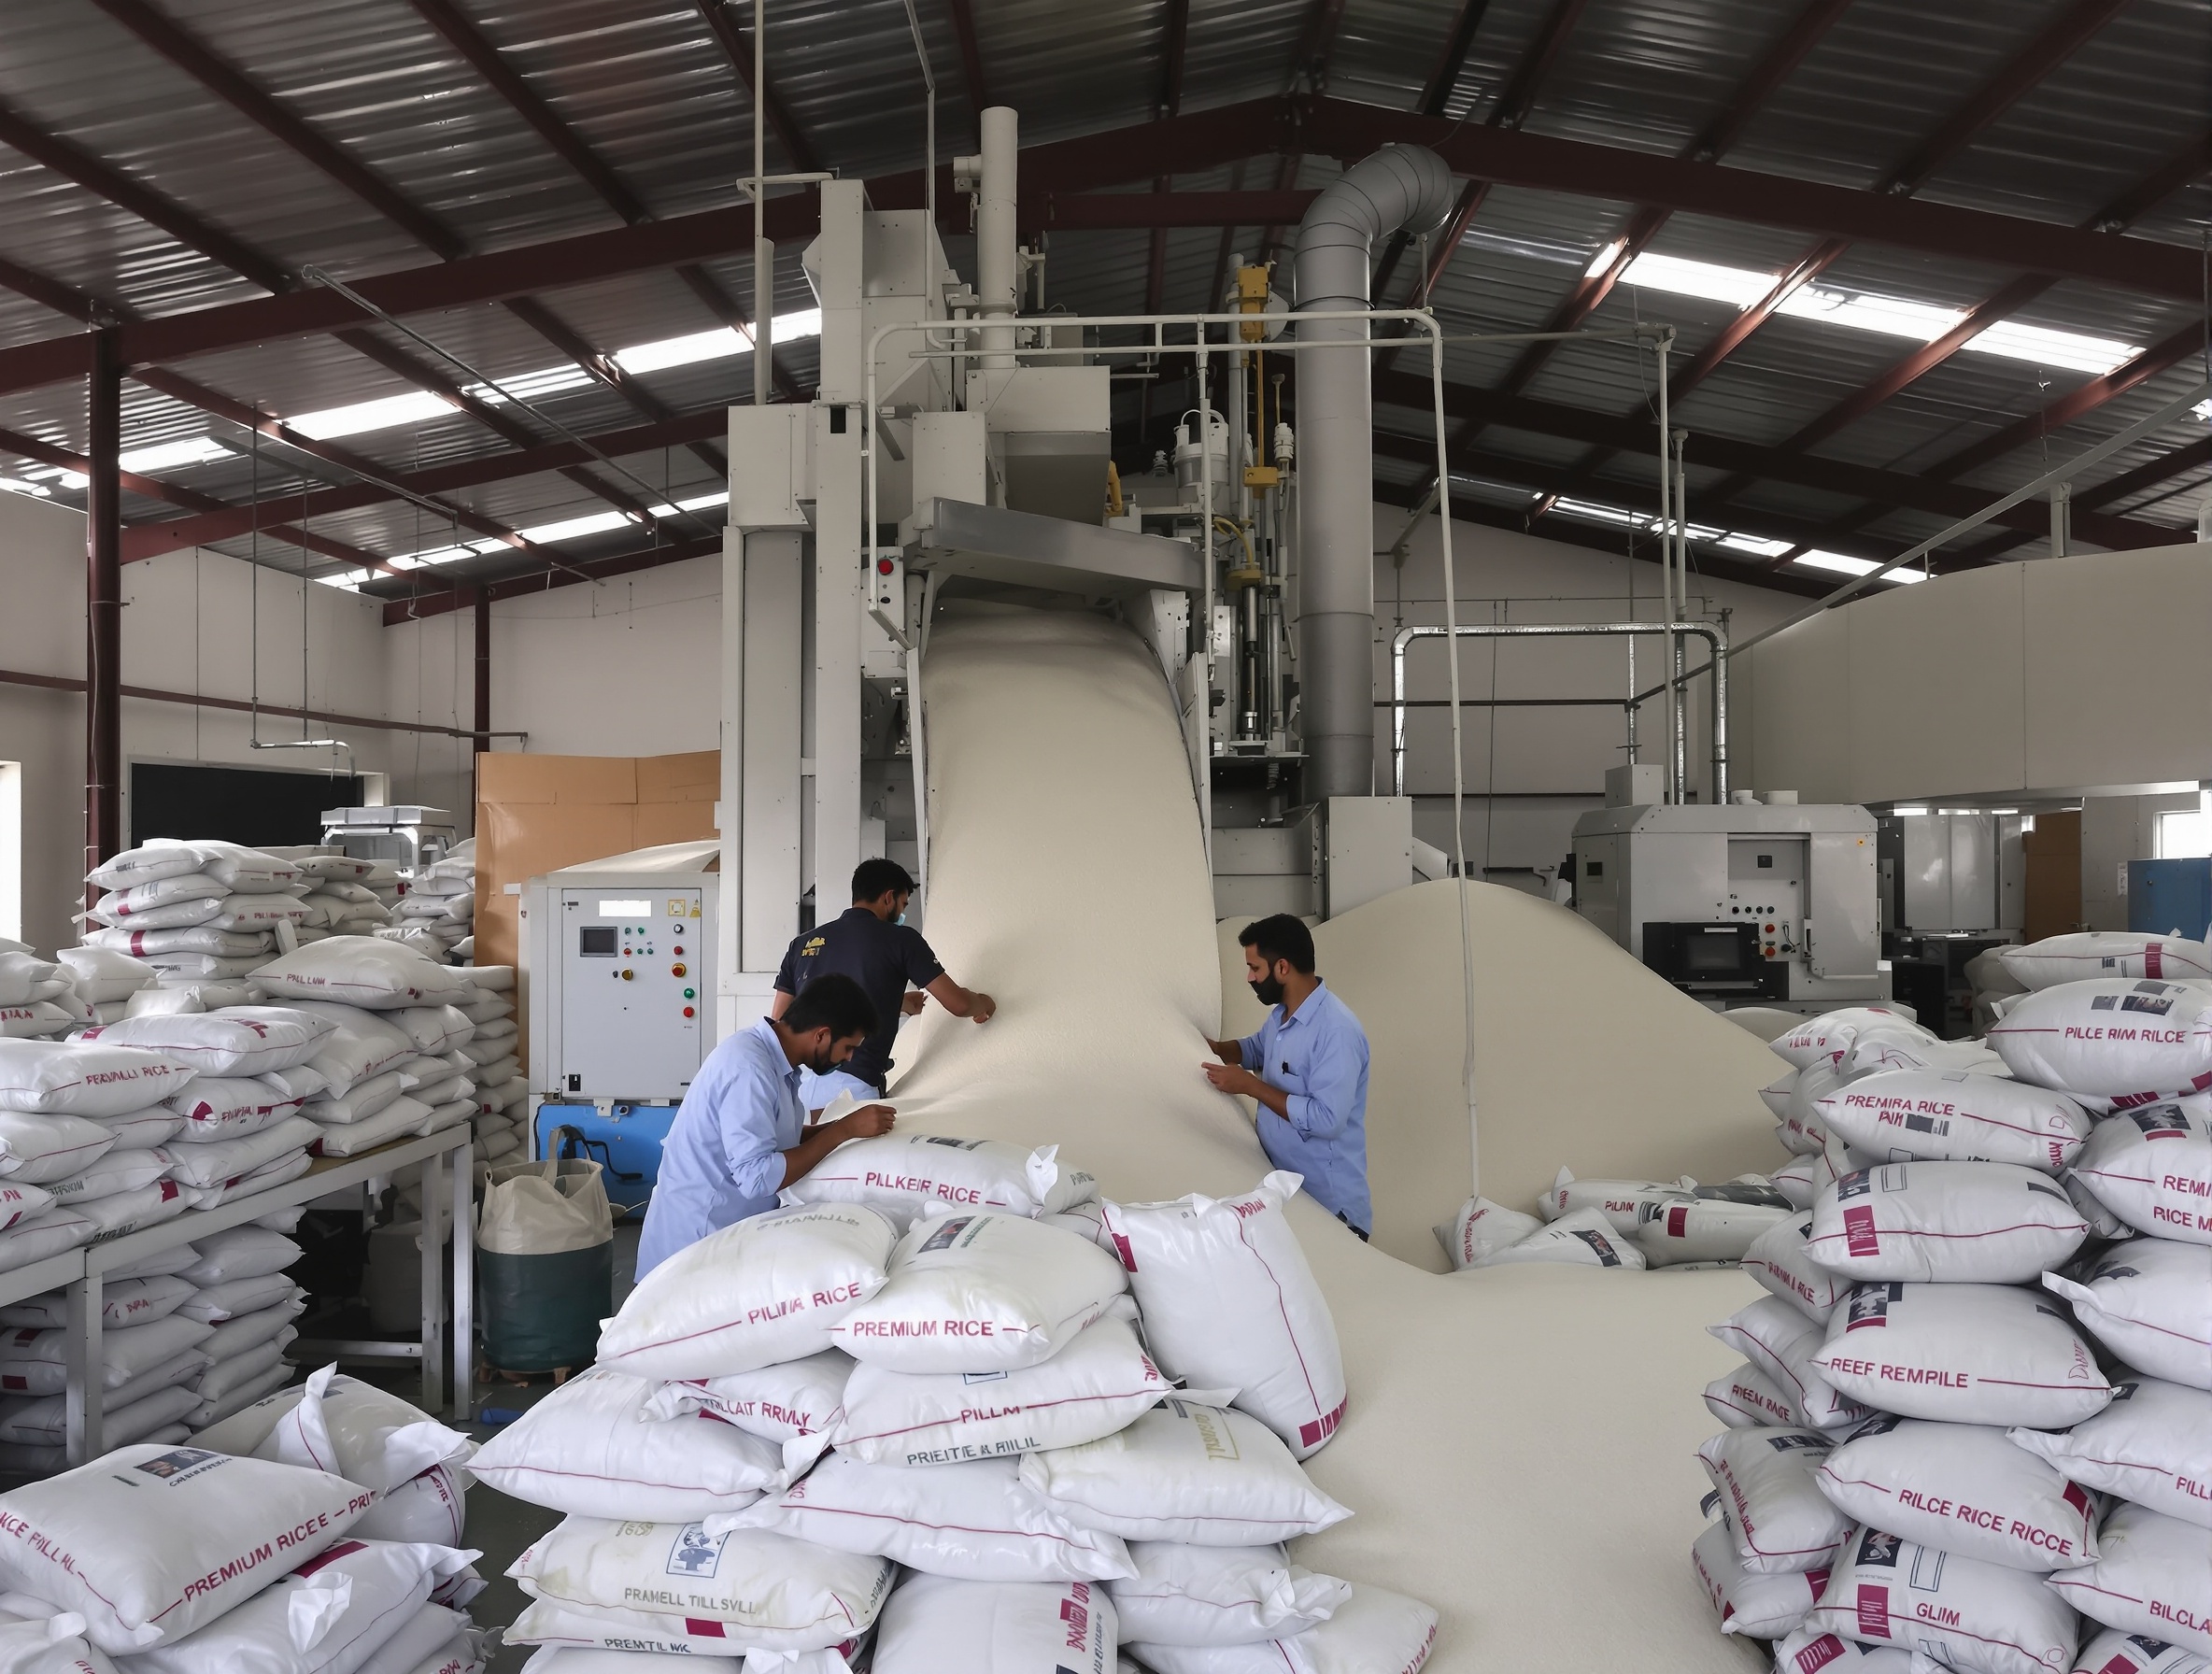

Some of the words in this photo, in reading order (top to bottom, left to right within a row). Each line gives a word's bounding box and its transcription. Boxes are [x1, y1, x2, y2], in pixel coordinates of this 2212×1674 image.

[1917, 1100, 1956, 1116] RICE
[937, 1184, 982, 1205] RICE
[2153, 1205, 2192, 1228] RICE
[812, 1282, 862, 1308] RICE
[853, 1320, 938, 1338] PREMIUM
[943, 1319, 994, 1338] RICE
[1830, 1357, 1876, 1376] REEF
[2177, 1476, 2212, 1500] PILL
[1898, 1489, 1953, 1516] RILCE
[1956, 1504, 2006, 1533] RICE
[2009, 1520, 2074, 1557] RICCE
[183, 1542, 274, 1603] PREMIUM
